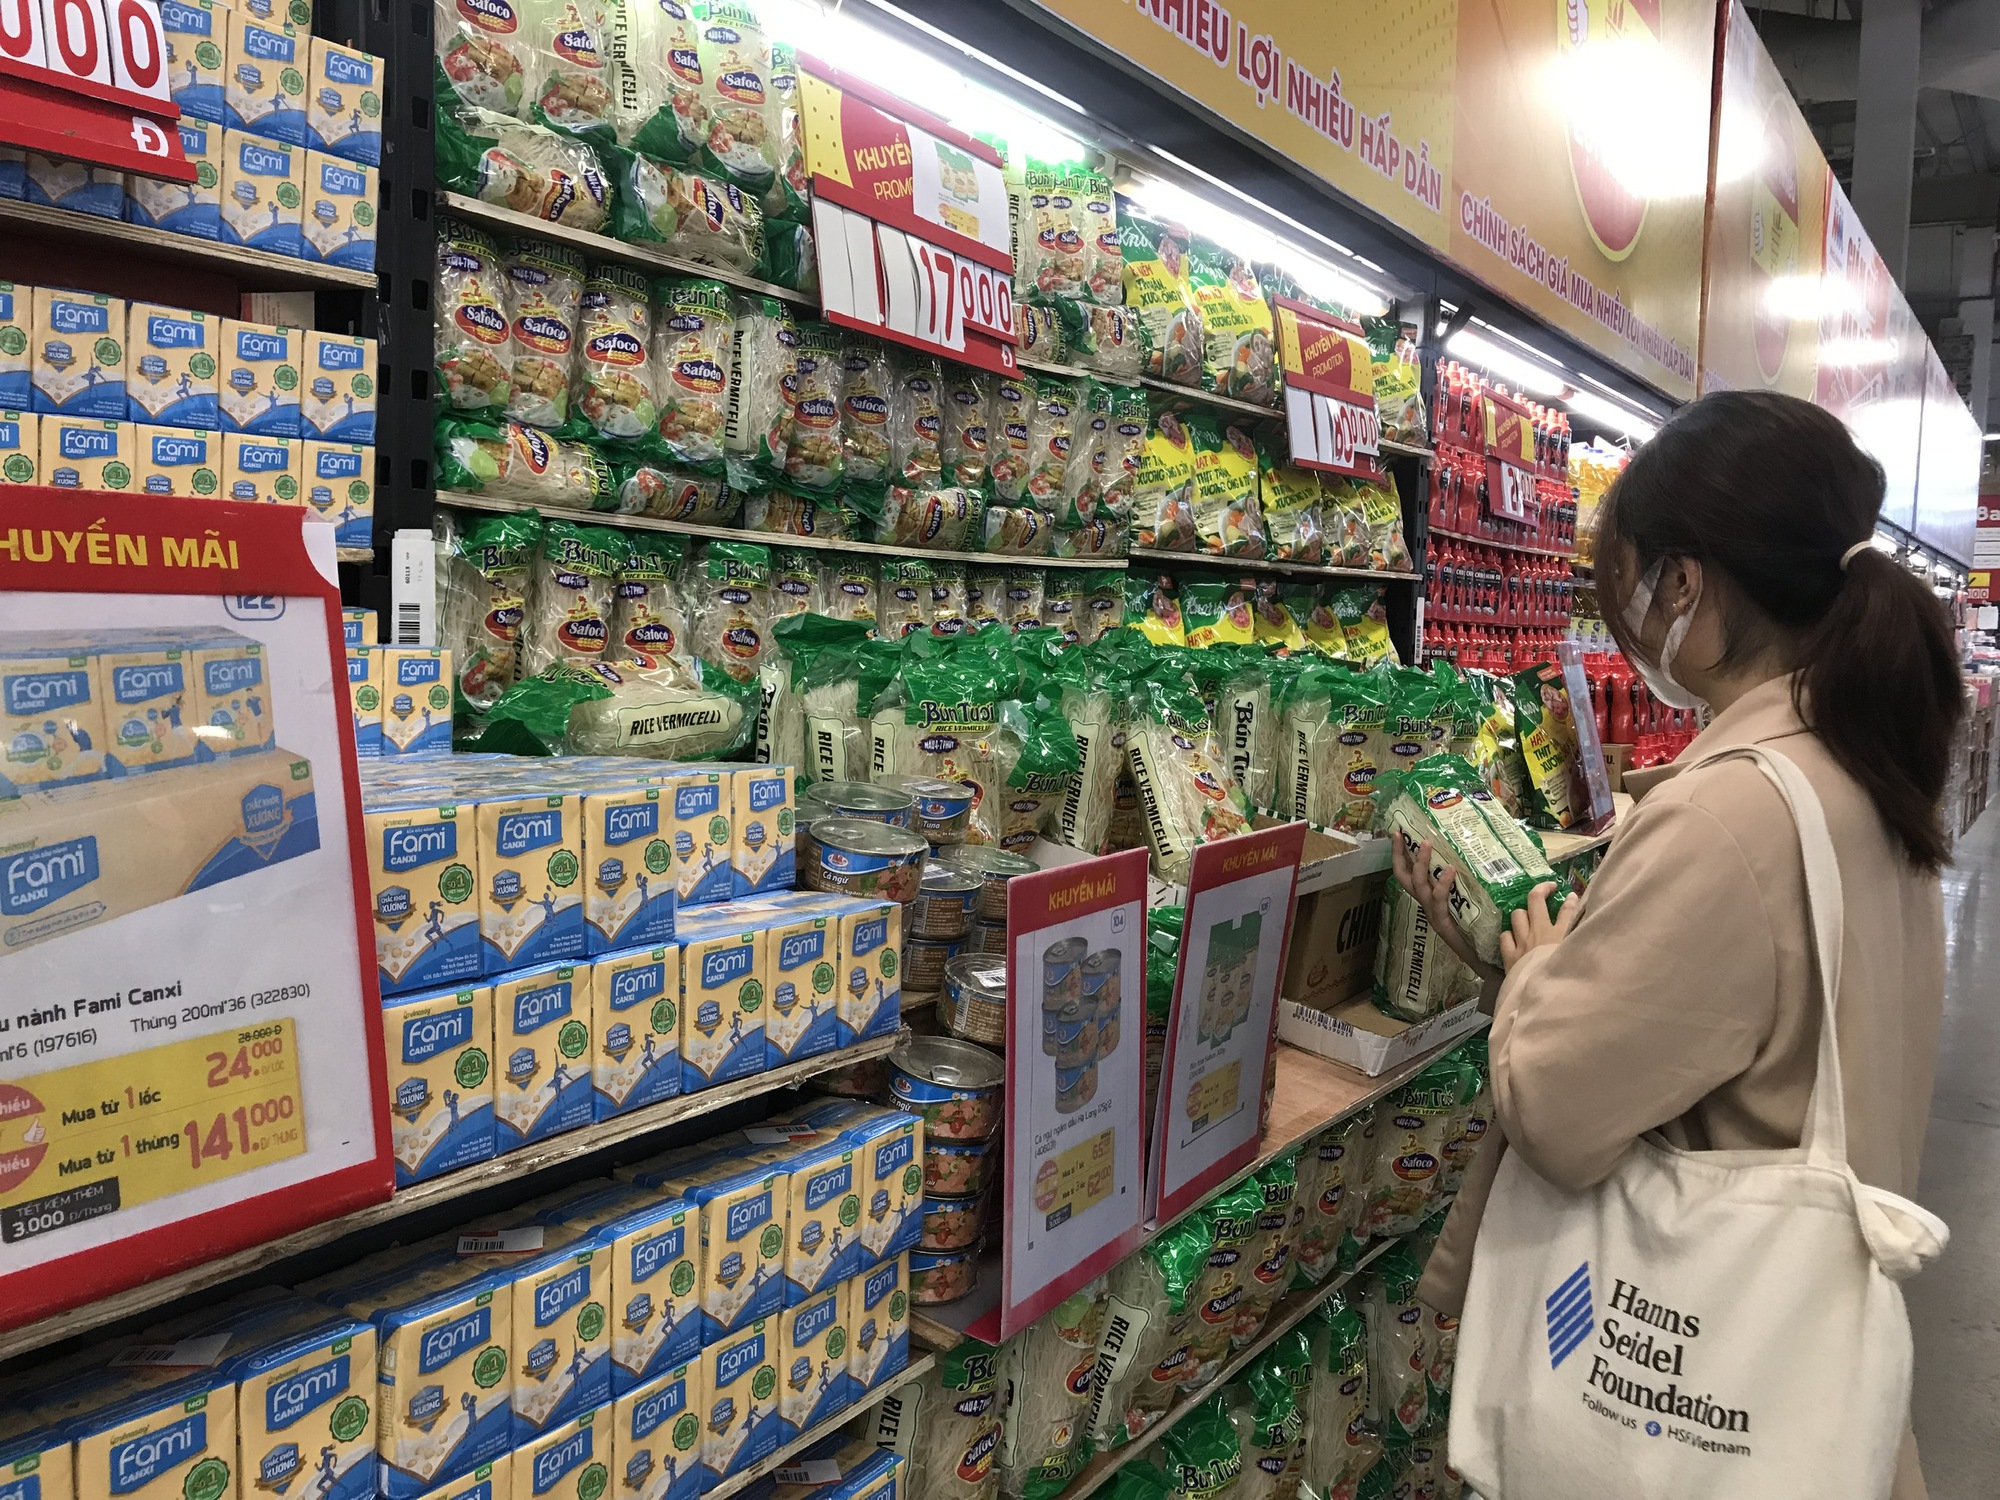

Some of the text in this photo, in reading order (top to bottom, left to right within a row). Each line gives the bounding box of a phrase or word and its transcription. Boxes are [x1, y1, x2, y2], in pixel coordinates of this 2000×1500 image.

[248, 31, 288, 55] Fami
[329, 51, 367, 80] Fami
[1238, 26, 1441, 211] LỢI NHIỀU HẤP DẪN
[243, 146, 283, 171] Fami
[324, 167, 360, 192] Fami
[1462, 193, 1507, 255] CHÍNH
[1510, 226, 1545, 282] SÁCH
[1548, 253, 1568, 299] GIÁ
[1571, 274, 1594, 315] MUA
[1597, 289, 1625, 335] NHIỀU
[55, 301, 99, 325] Fami
[466, 307, 503, 331] Safoco
[152, 319, 196, 342] Fami
[523, 317, 567, 341] Safoco
[241, 334, 280, 355] Fami
[323, 343, 357, 365] Fami
[596, 337, 639, 353] Safoco
[682, 363, 722, 382] Safoco
[1311, 351, 1344, 379] PROMOTION
[724, 361, 742, 440] VERMICELLI
[851, 398, 885, 413] Safoco
[64, 426, 108, 450] Fami
[156, 438, 198, 459] Fami
[161, 529, 239, 569] MÃI
[636, 629, 669, 642] Safoco
[730, 629, 756, 646] Safoco
[630, 710, 721, 737] RICE VERMICELLI
[918, 701, 957, 728] Bún
[1234, 699, 1253, 748] Bún
[817, 731, 833, 764] RICE
[873, 737, 884, 772] RICE
[1078, 734, 1090, 766] RICE
[1129, 747, 1172, 857] RICE VERMICELLI
[502, 815, 551, 841] Fami
[610, 807, 650, 830] Fami
[923, 820, 941, 830] Tuna
[390, 830, 446, 856] Fami
[503, 840, 525, 849] CANXI
[610, 830, 628, 839] CANXI
[391, 854, 416, 865] CANXI
[1222, 846, 1260, 873] KHUYẾN
[11, 887, 48, 907] CANXI
[1048, 874, 1117, 911] KHUYẾN MÃI
[382, 902, 407, 913] XƯƠNG
[1113, 914, 1125, 928] 104
[783, 933, 818, 958] Fami
[706, 950, 746, 976] Fami
[1406, 935, 1427, 1002] VERMICELLI
[615, 968, 656, 995] Fami
[17, 1005, 67, 1029] nành
[73, 992, 122, 1018] Fami
[127, 980, 182, 1006] Canxi
[130, 983, 311, 1034] Thùng (322830)
[518, 989, 567, 1018] Fami
[615, 994, 635, 1005] CANXI
[409, 1013, 462, 1047] Fami
[519, 1016, 539, 1027] CANXI
[33, 1027, 98, 1058] (197616)
[409, 1044, 434, 1056] CANXI
[62, 1086, 161, 1126] Mua từ 1 lốc
[400, 1091, 425, 1106] XƯƠNG
[58, 1130, 180, 1177] Mua từ 1 thùng
[1401, 1157, 1433, 1169] Safoco
[808, 1171, 846, 1199] Fami
[12, 1210, 64, 1238] 3.000
[730, 1197, 767, 1227] Fami
[635, 1234, 677, 1268] Fami
[540, 1272, 582, 1309] Fami
[1608, 1279, 1700, 1338] Hanns
[426, 1315, 480, 1352] Fami
[1104, 1314, 1130, 1352] RICE
[720, 1341, 758, 1373] Fami
[1599, 1318, 1684, 1376] Seidel
[273, 1364, 338, 1413] Fami
[1587, 1354, 1750, 1433] Foundation
[274, 1403, 304, 1422] CANXI
[637, 1388, 677, 1422] Fami
[1582, 1392, 1620, 1420] Follow
[1621, 1415, 1637, 1430] us
[120, 1422, 192, 1474] Fami
[539, 1434, 584, 1472] Fami
[120, 1465, 154, 1486] CANXI
[266, 1458, 296, 1479] XƯƠNG
